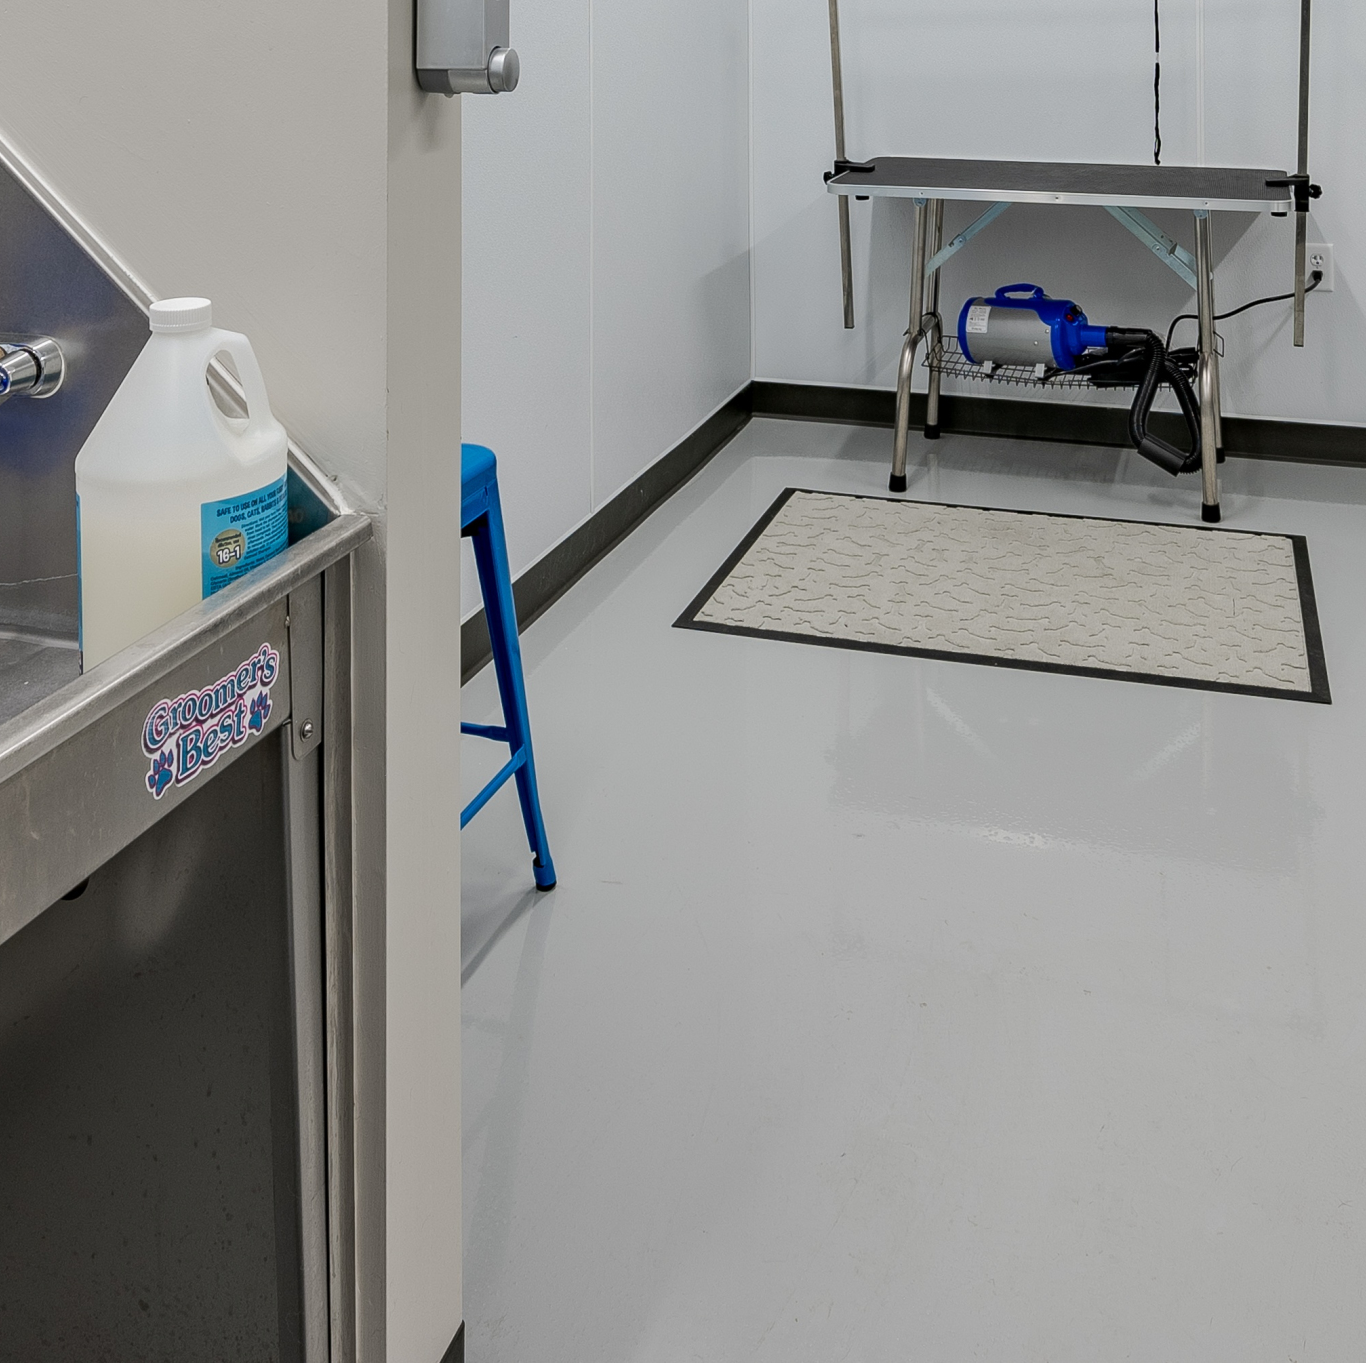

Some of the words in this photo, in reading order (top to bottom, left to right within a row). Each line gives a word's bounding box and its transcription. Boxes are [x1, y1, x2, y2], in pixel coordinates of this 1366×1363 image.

[216, 507, 231, 517] SAFE
[233, 505, 240, 513] TO
[241, 501, 250, 510] USE
[259, 494, 267, 504] ALL
[217, 545, 242, 564] 16-1
[146, 647, 277, 748] Groomer's
[178, 700, 246, 779] Best
